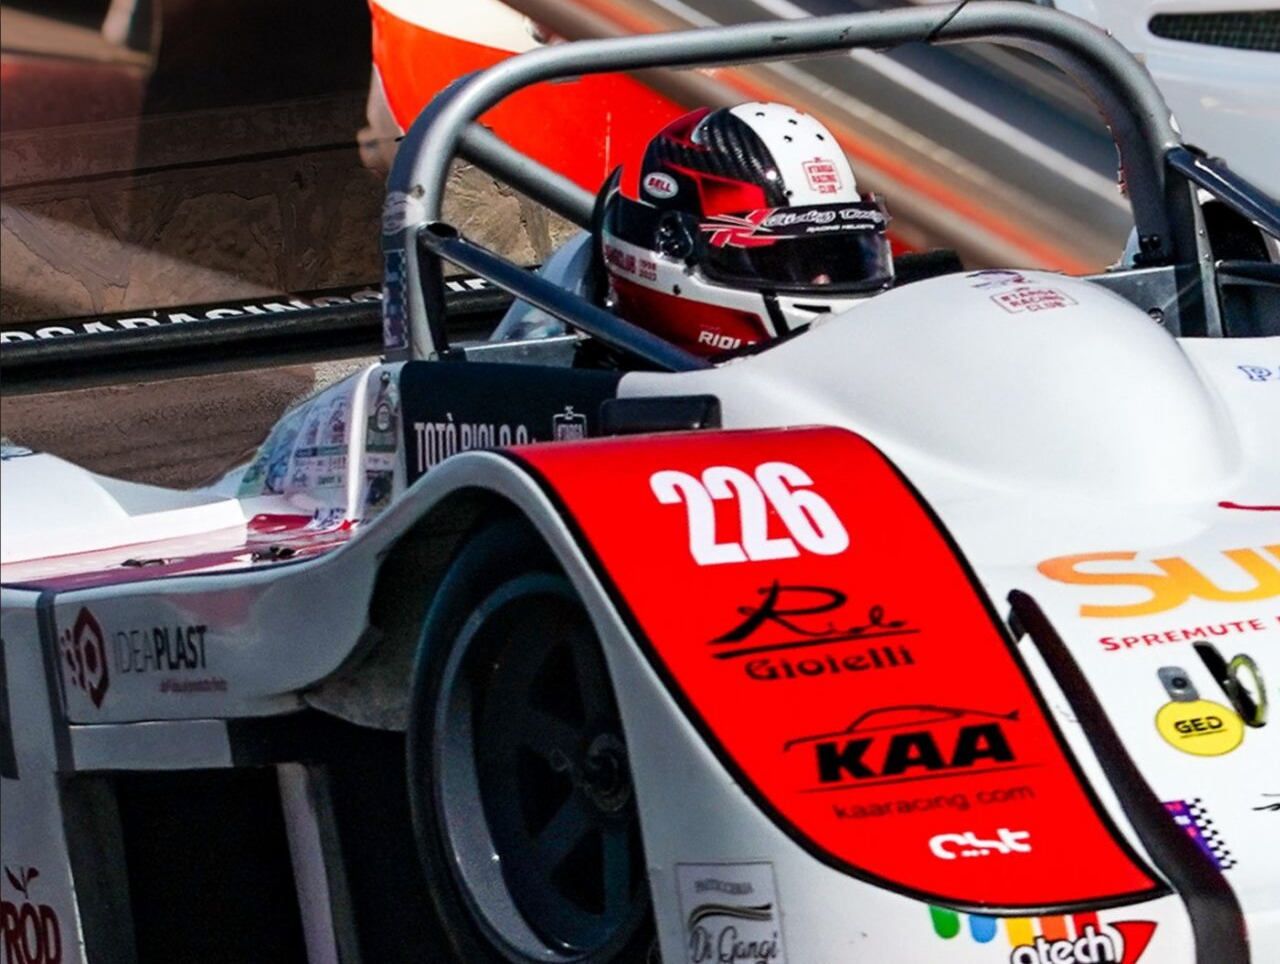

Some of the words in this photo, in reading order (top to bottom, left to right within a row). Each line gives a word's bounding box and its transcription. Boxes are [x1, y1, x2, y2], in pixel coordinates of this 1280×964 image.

[648, 176, 671, 193] BELL
[649, 461, 850, 566] 226
[110, 624, 208, 674] IDEAPLAST
[1098, 618, 1266, 653] SPREMUTE
[744, 646, 915, 681] Gioielli
[1174, 715, 1224, 735] GED
[815, 722, 1016, 783] KAA
